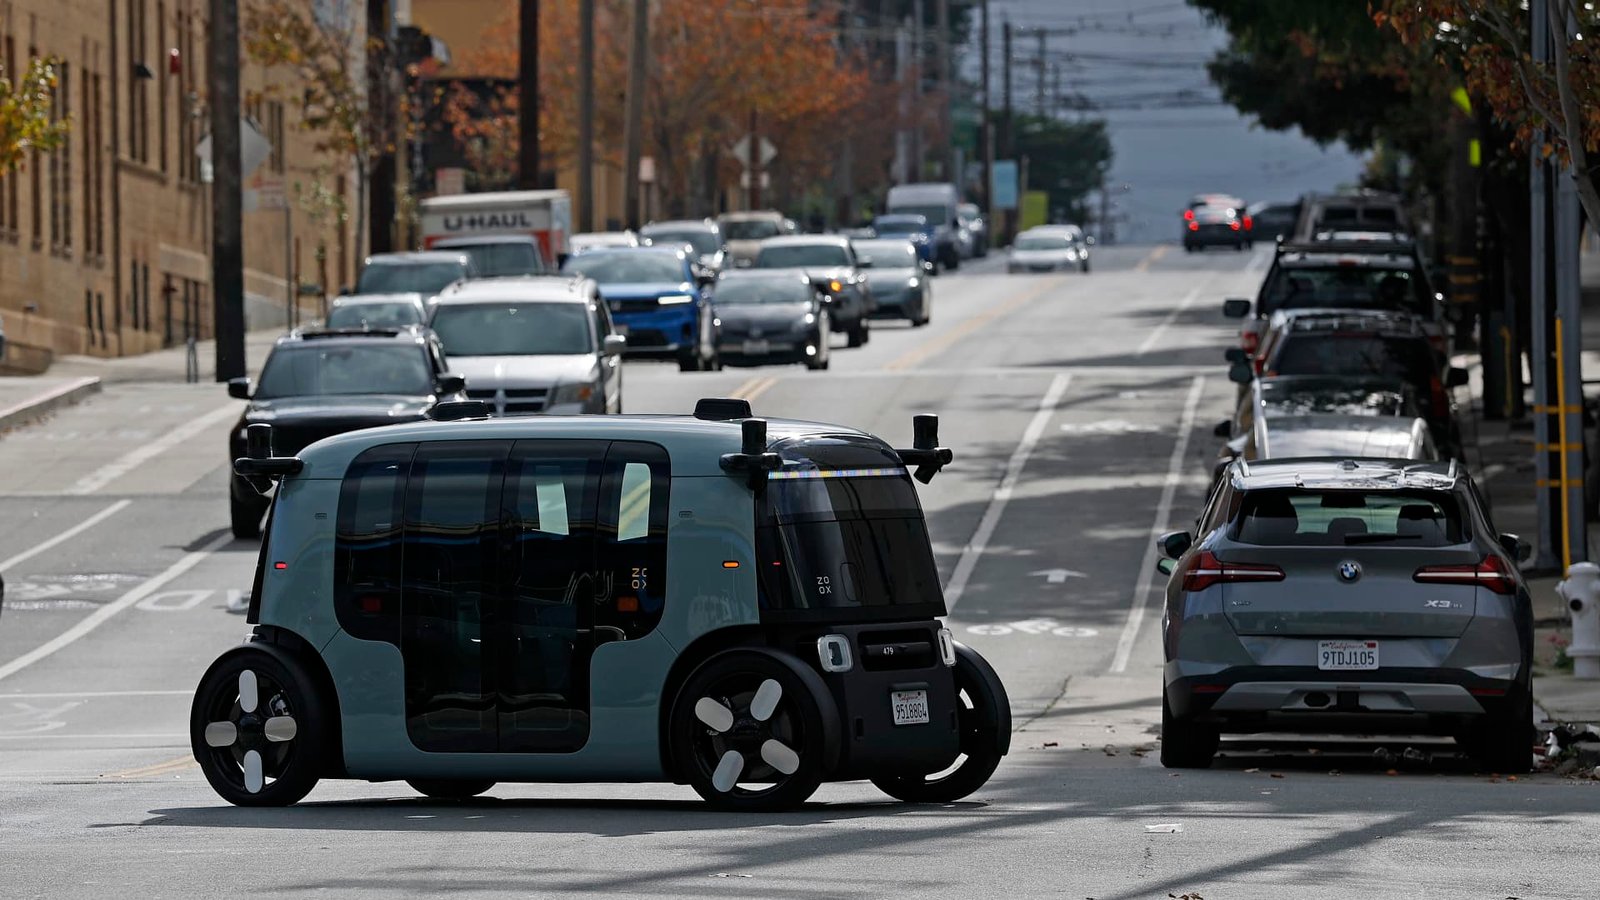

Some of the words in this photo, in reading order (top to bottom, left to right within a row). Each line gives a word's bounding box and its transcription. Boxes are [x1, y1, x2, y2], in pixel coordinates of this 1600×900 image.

[443, 212, 531, 231] U-HAUL
[816, 576, 830, 585] ZO
[818, 585, 832, 594] OX
[1424, 600, 1450, 608] X3
[1322, 651, 1375, 665] 9TDJ105
